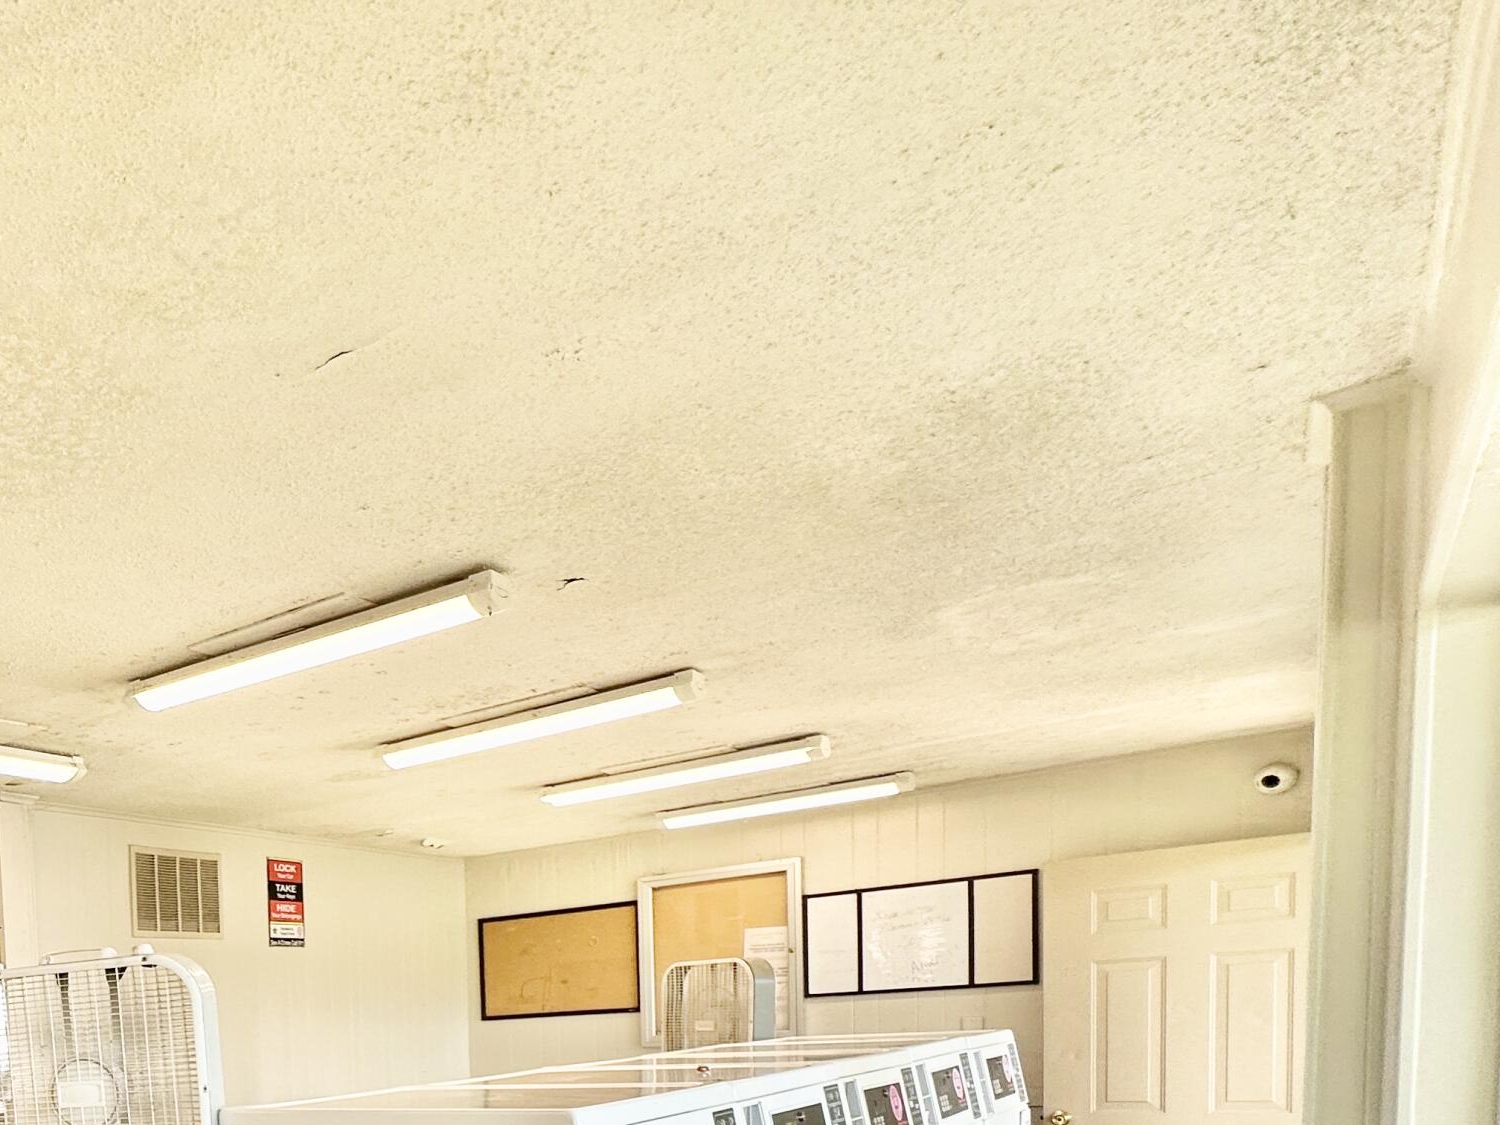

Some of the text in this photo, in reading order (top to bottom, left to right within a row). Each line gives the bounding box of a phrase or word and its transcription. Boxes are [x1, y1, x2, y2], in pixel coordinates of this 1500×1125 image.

[273, 863, 297, 873] LOCK
[275, 883, 297, 893] TAKE
[276, 904, 297, 913] HIDE
